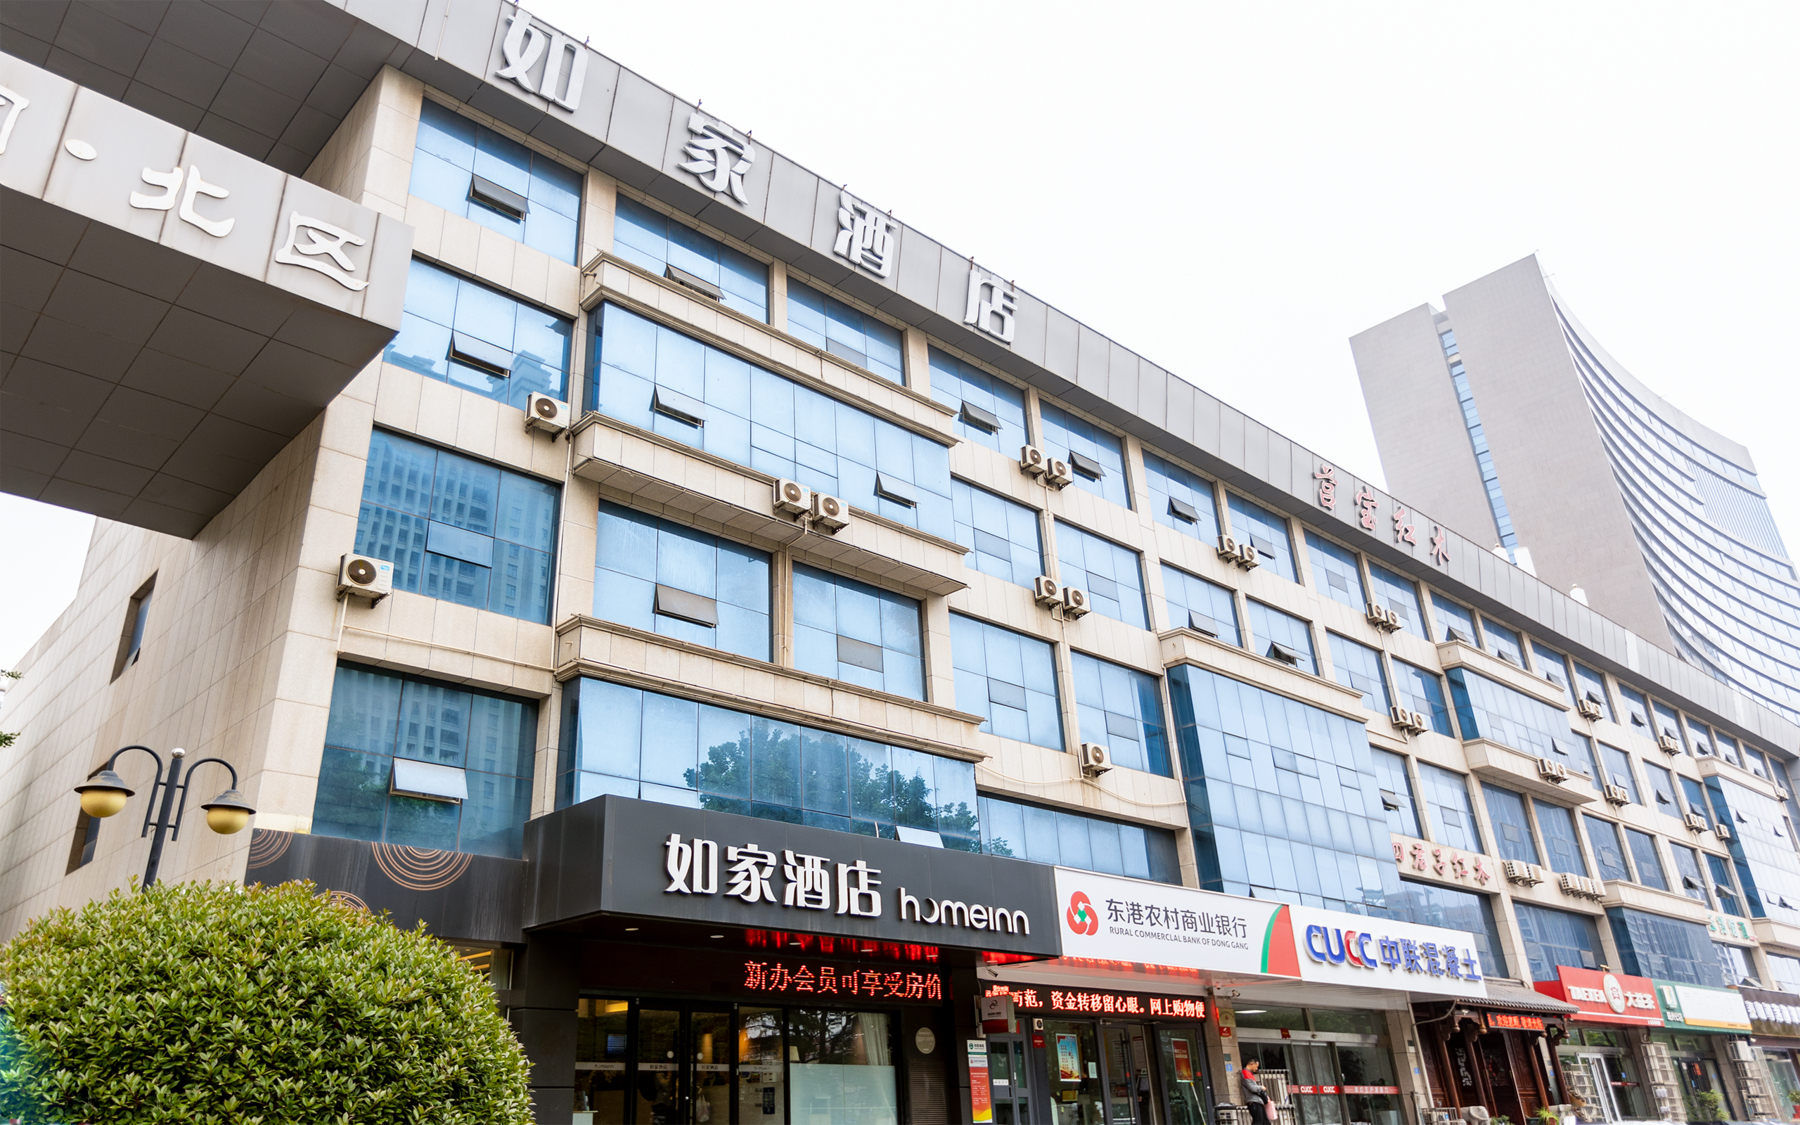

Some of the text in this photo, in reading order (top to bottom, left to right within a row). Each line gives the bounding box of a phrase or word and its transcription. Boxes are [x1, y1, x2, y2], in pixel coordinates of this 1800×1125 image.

[495, 9, 1019, 344] 如家酒店
[664, 833, 883, 918] 如家酒店
[898, 887, 1030, 935] homeinn
[1105, 899, 1247, 939] 东港农村商业银行
[1109, 926, 1133, 937] RURAL
[1183, 935, 1201, 945] BANK
[1202, 937, 1211, 946] OF
[1212, 939, 1230, 949] DONG
[1231, 941, 1249, 951] GANG
[1303, 925, 1378, 968] CUCC
[1377, 935, 1482, 981] 中联混凝土
[744, 960, 942, 1000] 新办会员可享受房价
[1568, 986, 1607, 1003] TAETEA
[1624, 991, 1656, 1010] 大益茶
